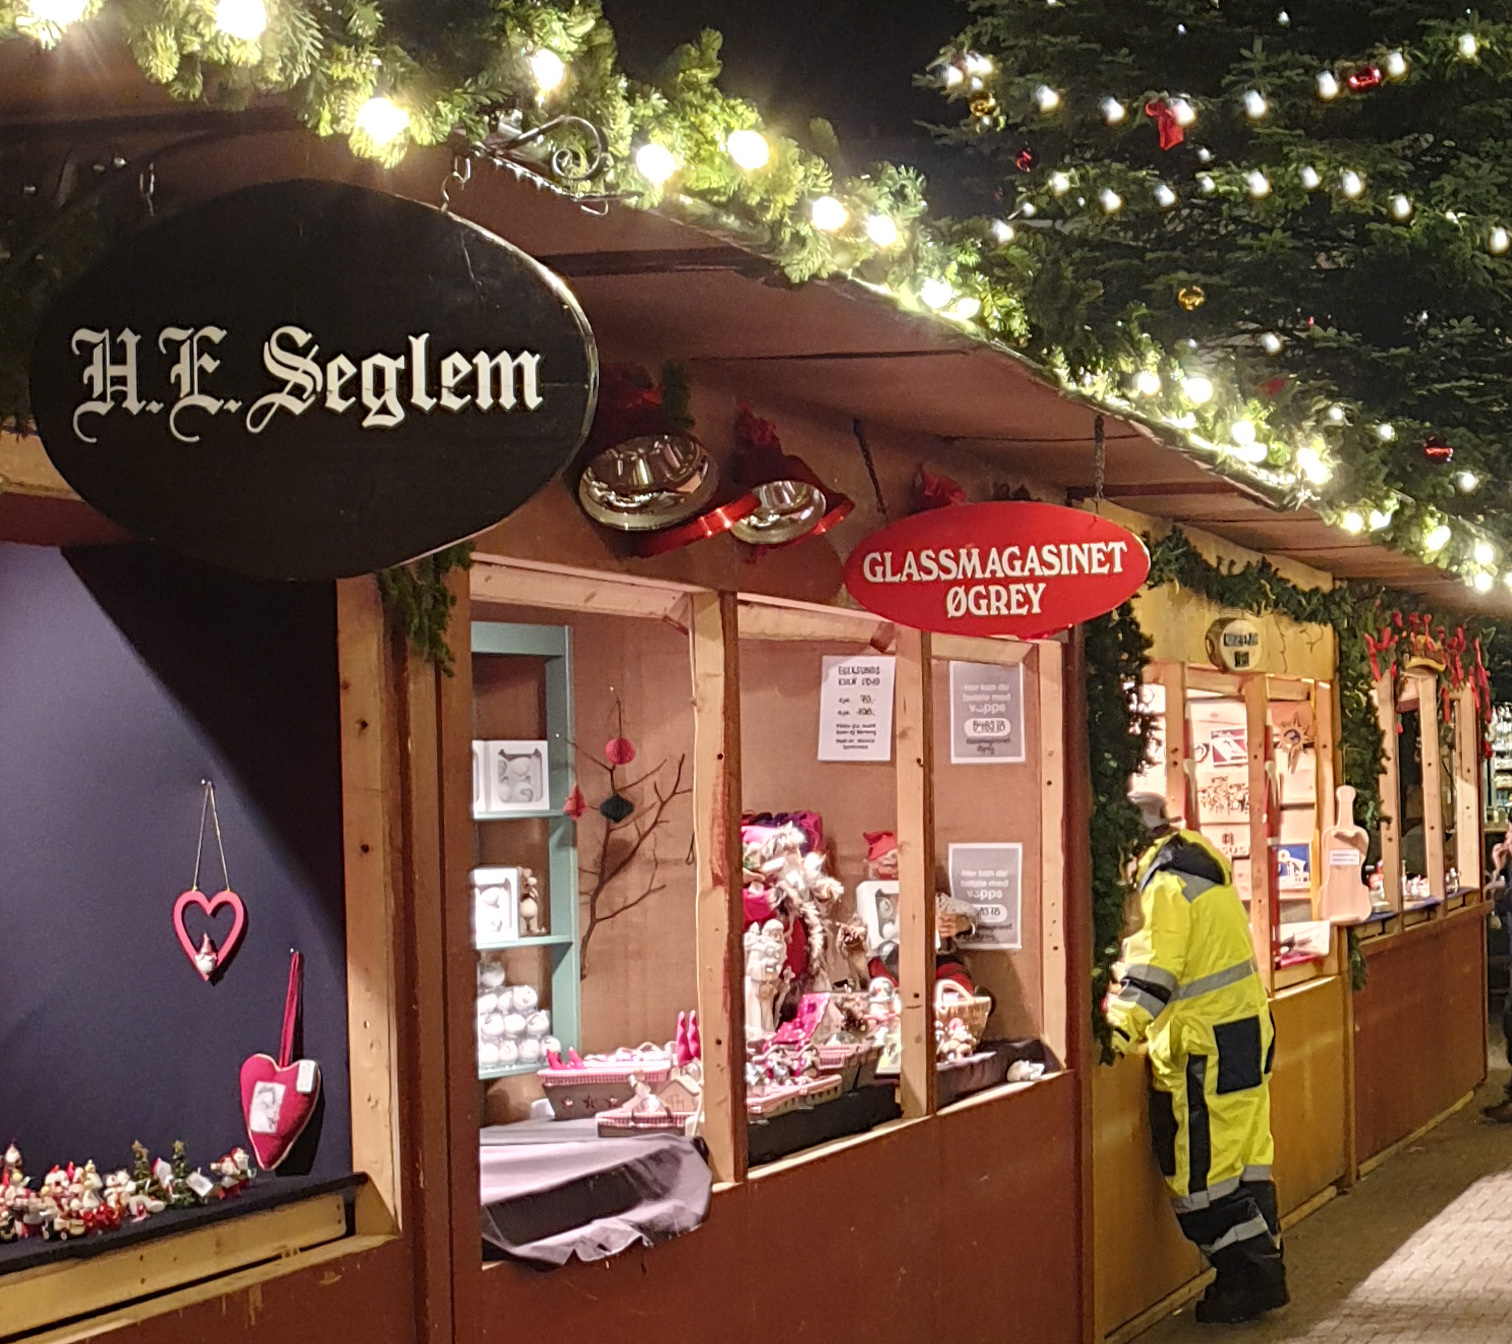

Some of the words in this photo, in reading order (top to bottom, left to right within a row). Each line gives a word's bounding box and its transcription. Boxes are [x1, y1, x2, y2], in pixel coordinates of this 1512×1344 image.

[246, 325, 543, 434] Seglem
[862, 541, 1127, 583] GLASSMAGASINET
[946, 582, 1046, 618] ØGREY
